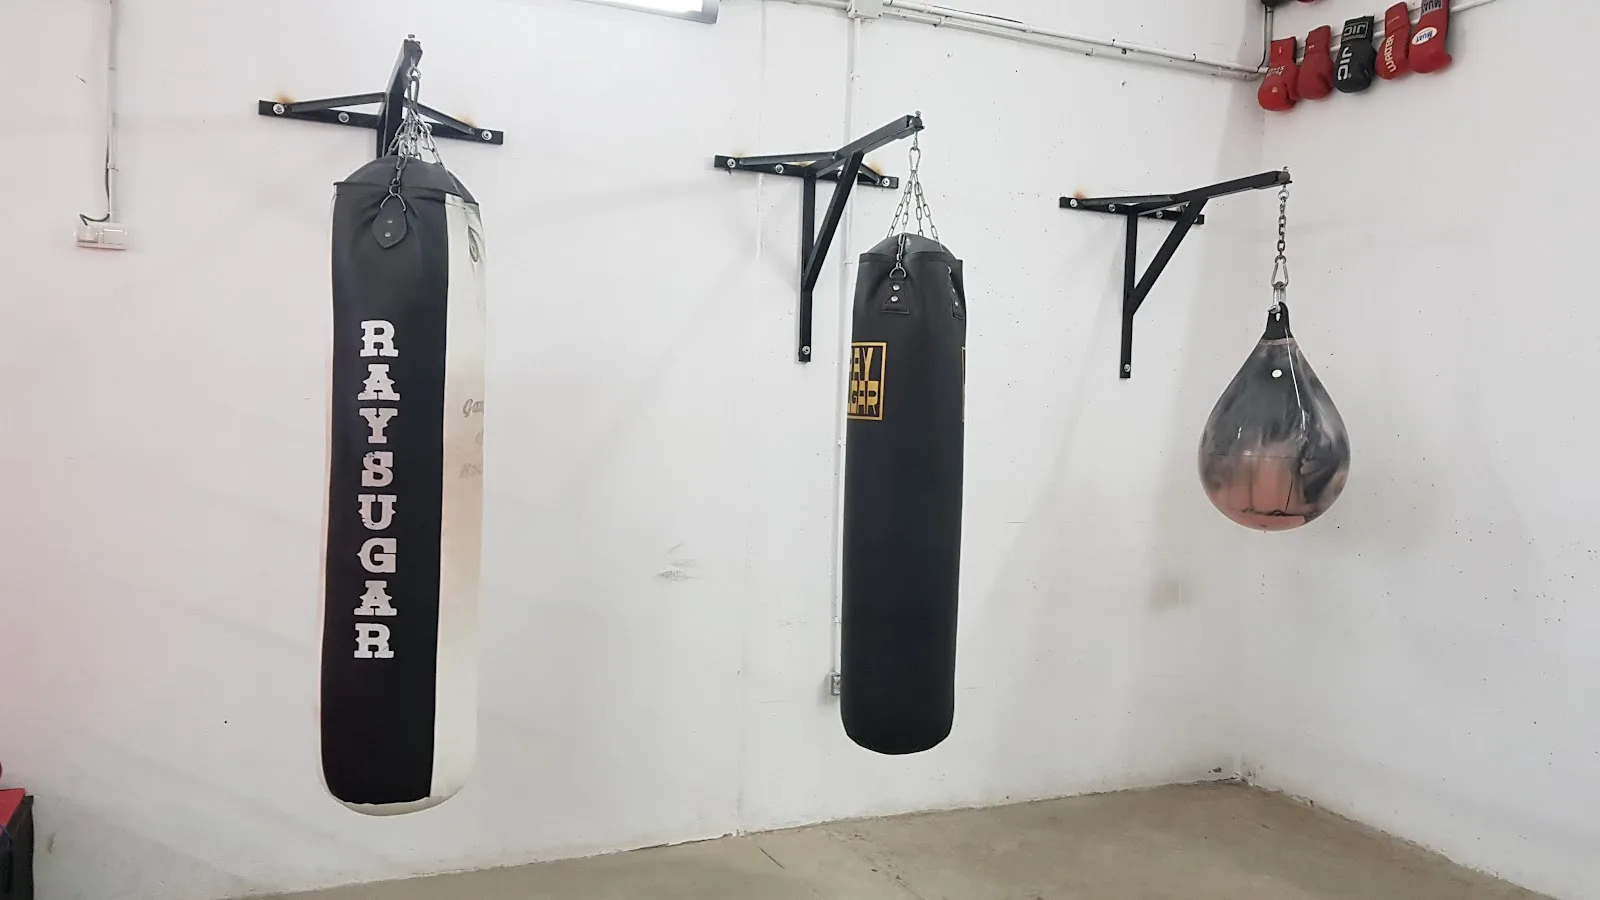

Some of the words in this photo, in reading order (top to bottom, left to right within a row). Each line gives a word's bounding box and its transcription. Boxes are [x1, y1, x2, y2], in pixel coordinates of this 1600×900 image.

[1343, 24, 1366, 37] JIC
[1415, 30, 1433, 43] MUAY
[1337, 46, 1353, 81] JIC
[1384, 34, 1397, 73] WALTER
[850, 347, 874, 381] AY
[848, 380, 879, 415] GAR
[353, 320, 400, 659] RAYSUGAR
